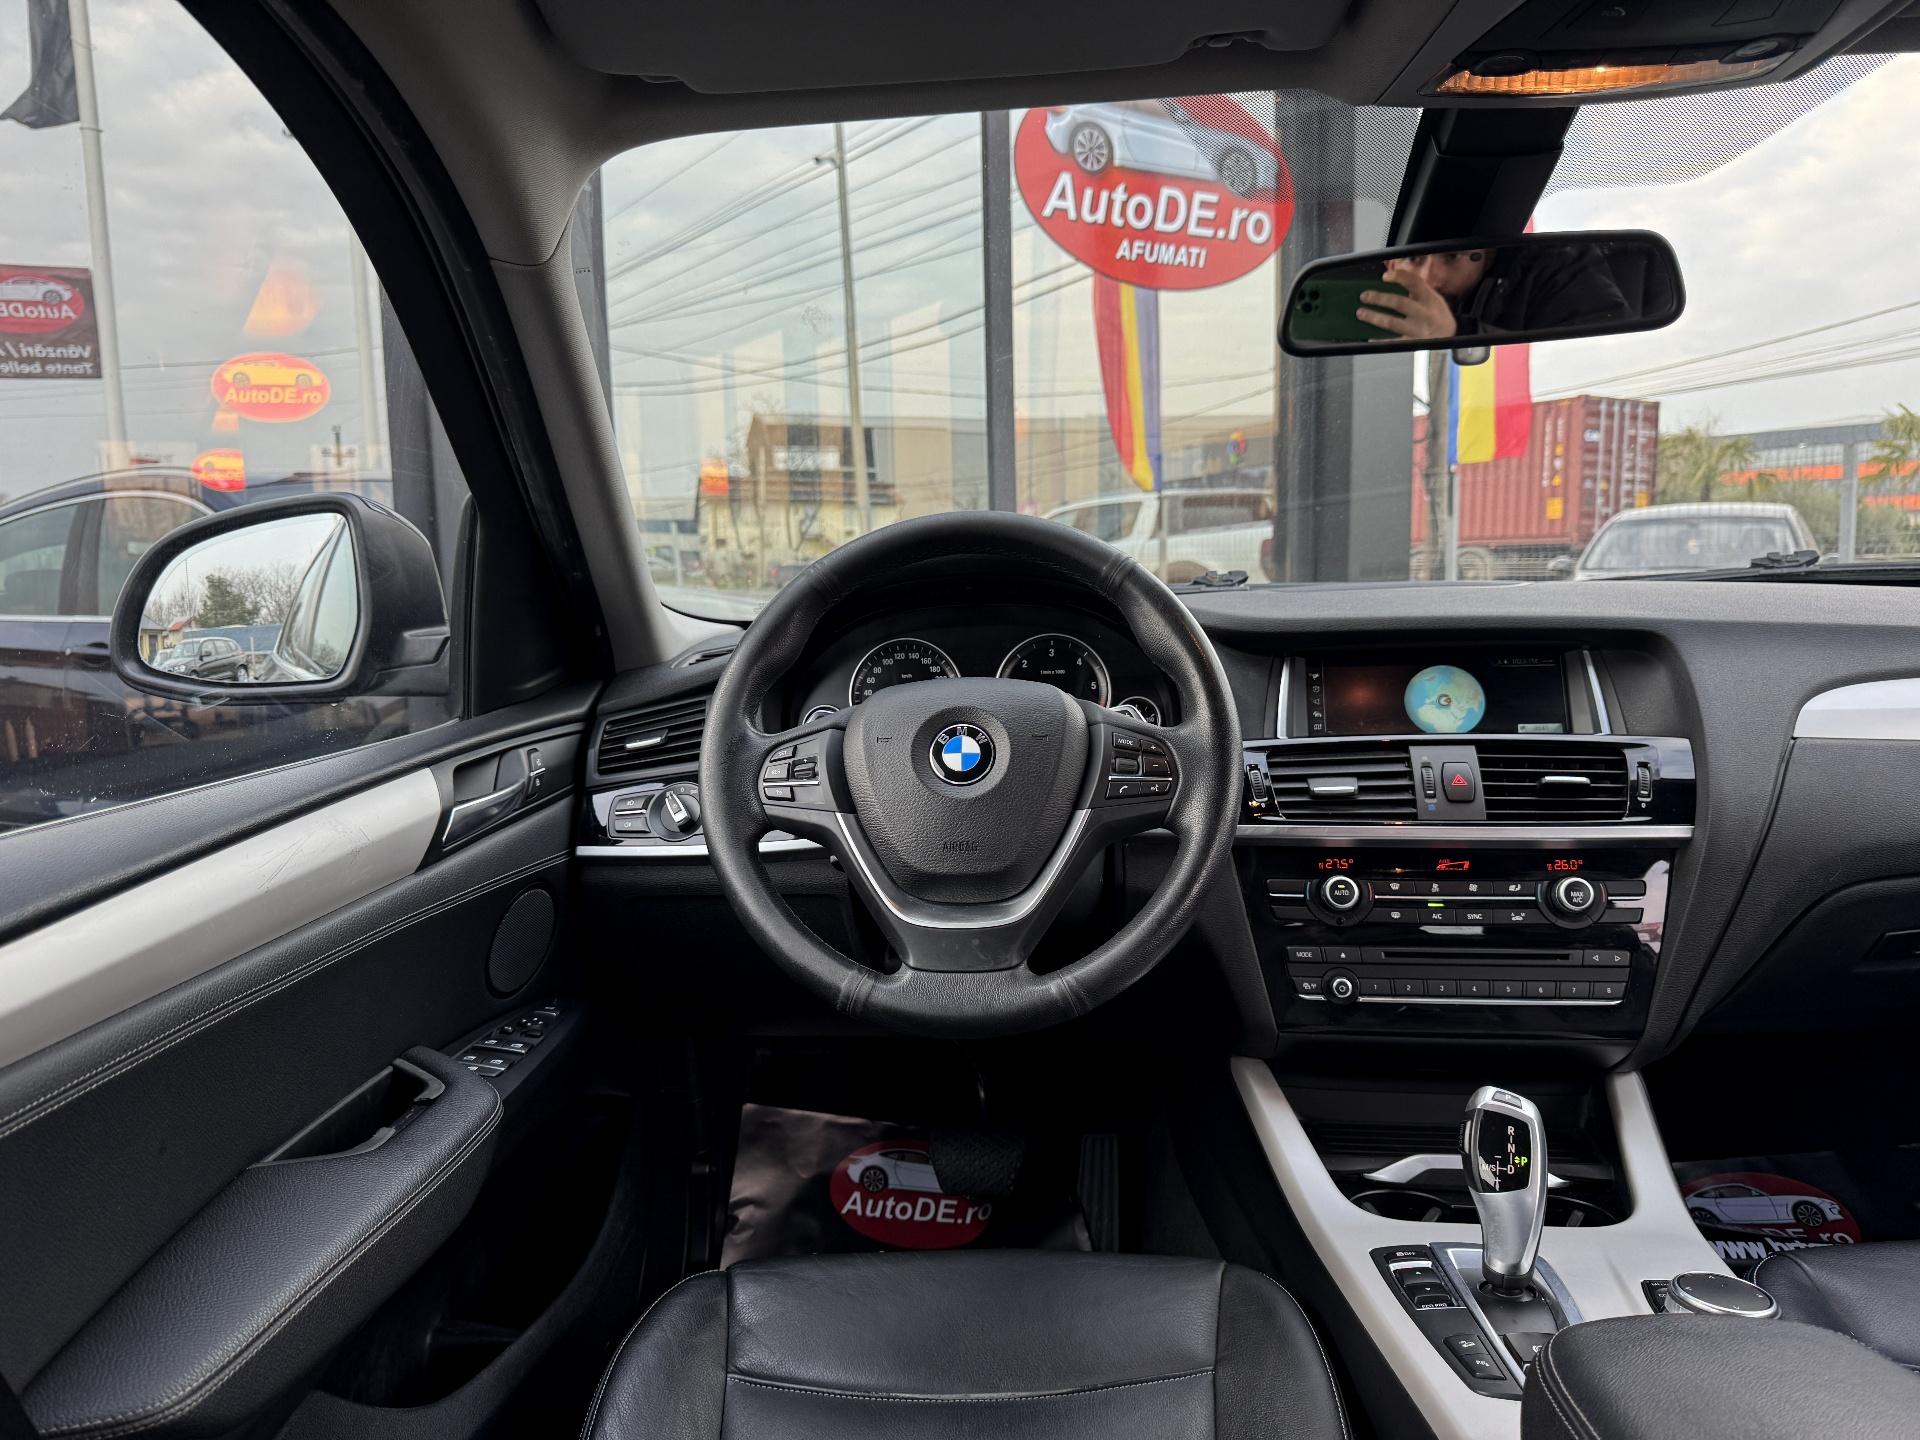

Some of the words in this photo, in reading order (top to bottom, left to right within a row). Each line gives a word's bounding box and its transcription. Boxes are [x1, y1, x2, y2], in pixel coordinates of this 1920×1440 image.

[1042, 172, 1272, 245] AutoDE.ro
[1116, 239, 1207, 269] AFUMATI
[1049, 649, 1055, 657] 3
[1022, 660, 1028, 668] 2
[1076, 658, 1082, 666] 4
[1090, 682, 1097, 690] 5
[938, 726, 988, 745] BMW
[1117, 738, 1134, 746] MODE
[1507, 1125, 1515, 1136] R
[1507, 1143, 1515, 1154] N
[1521, 1156, 1528, 1166] P
[1507, 1164, 1515, 1174] D
[841, 1190, 992, 1226] AutoDE.ro
